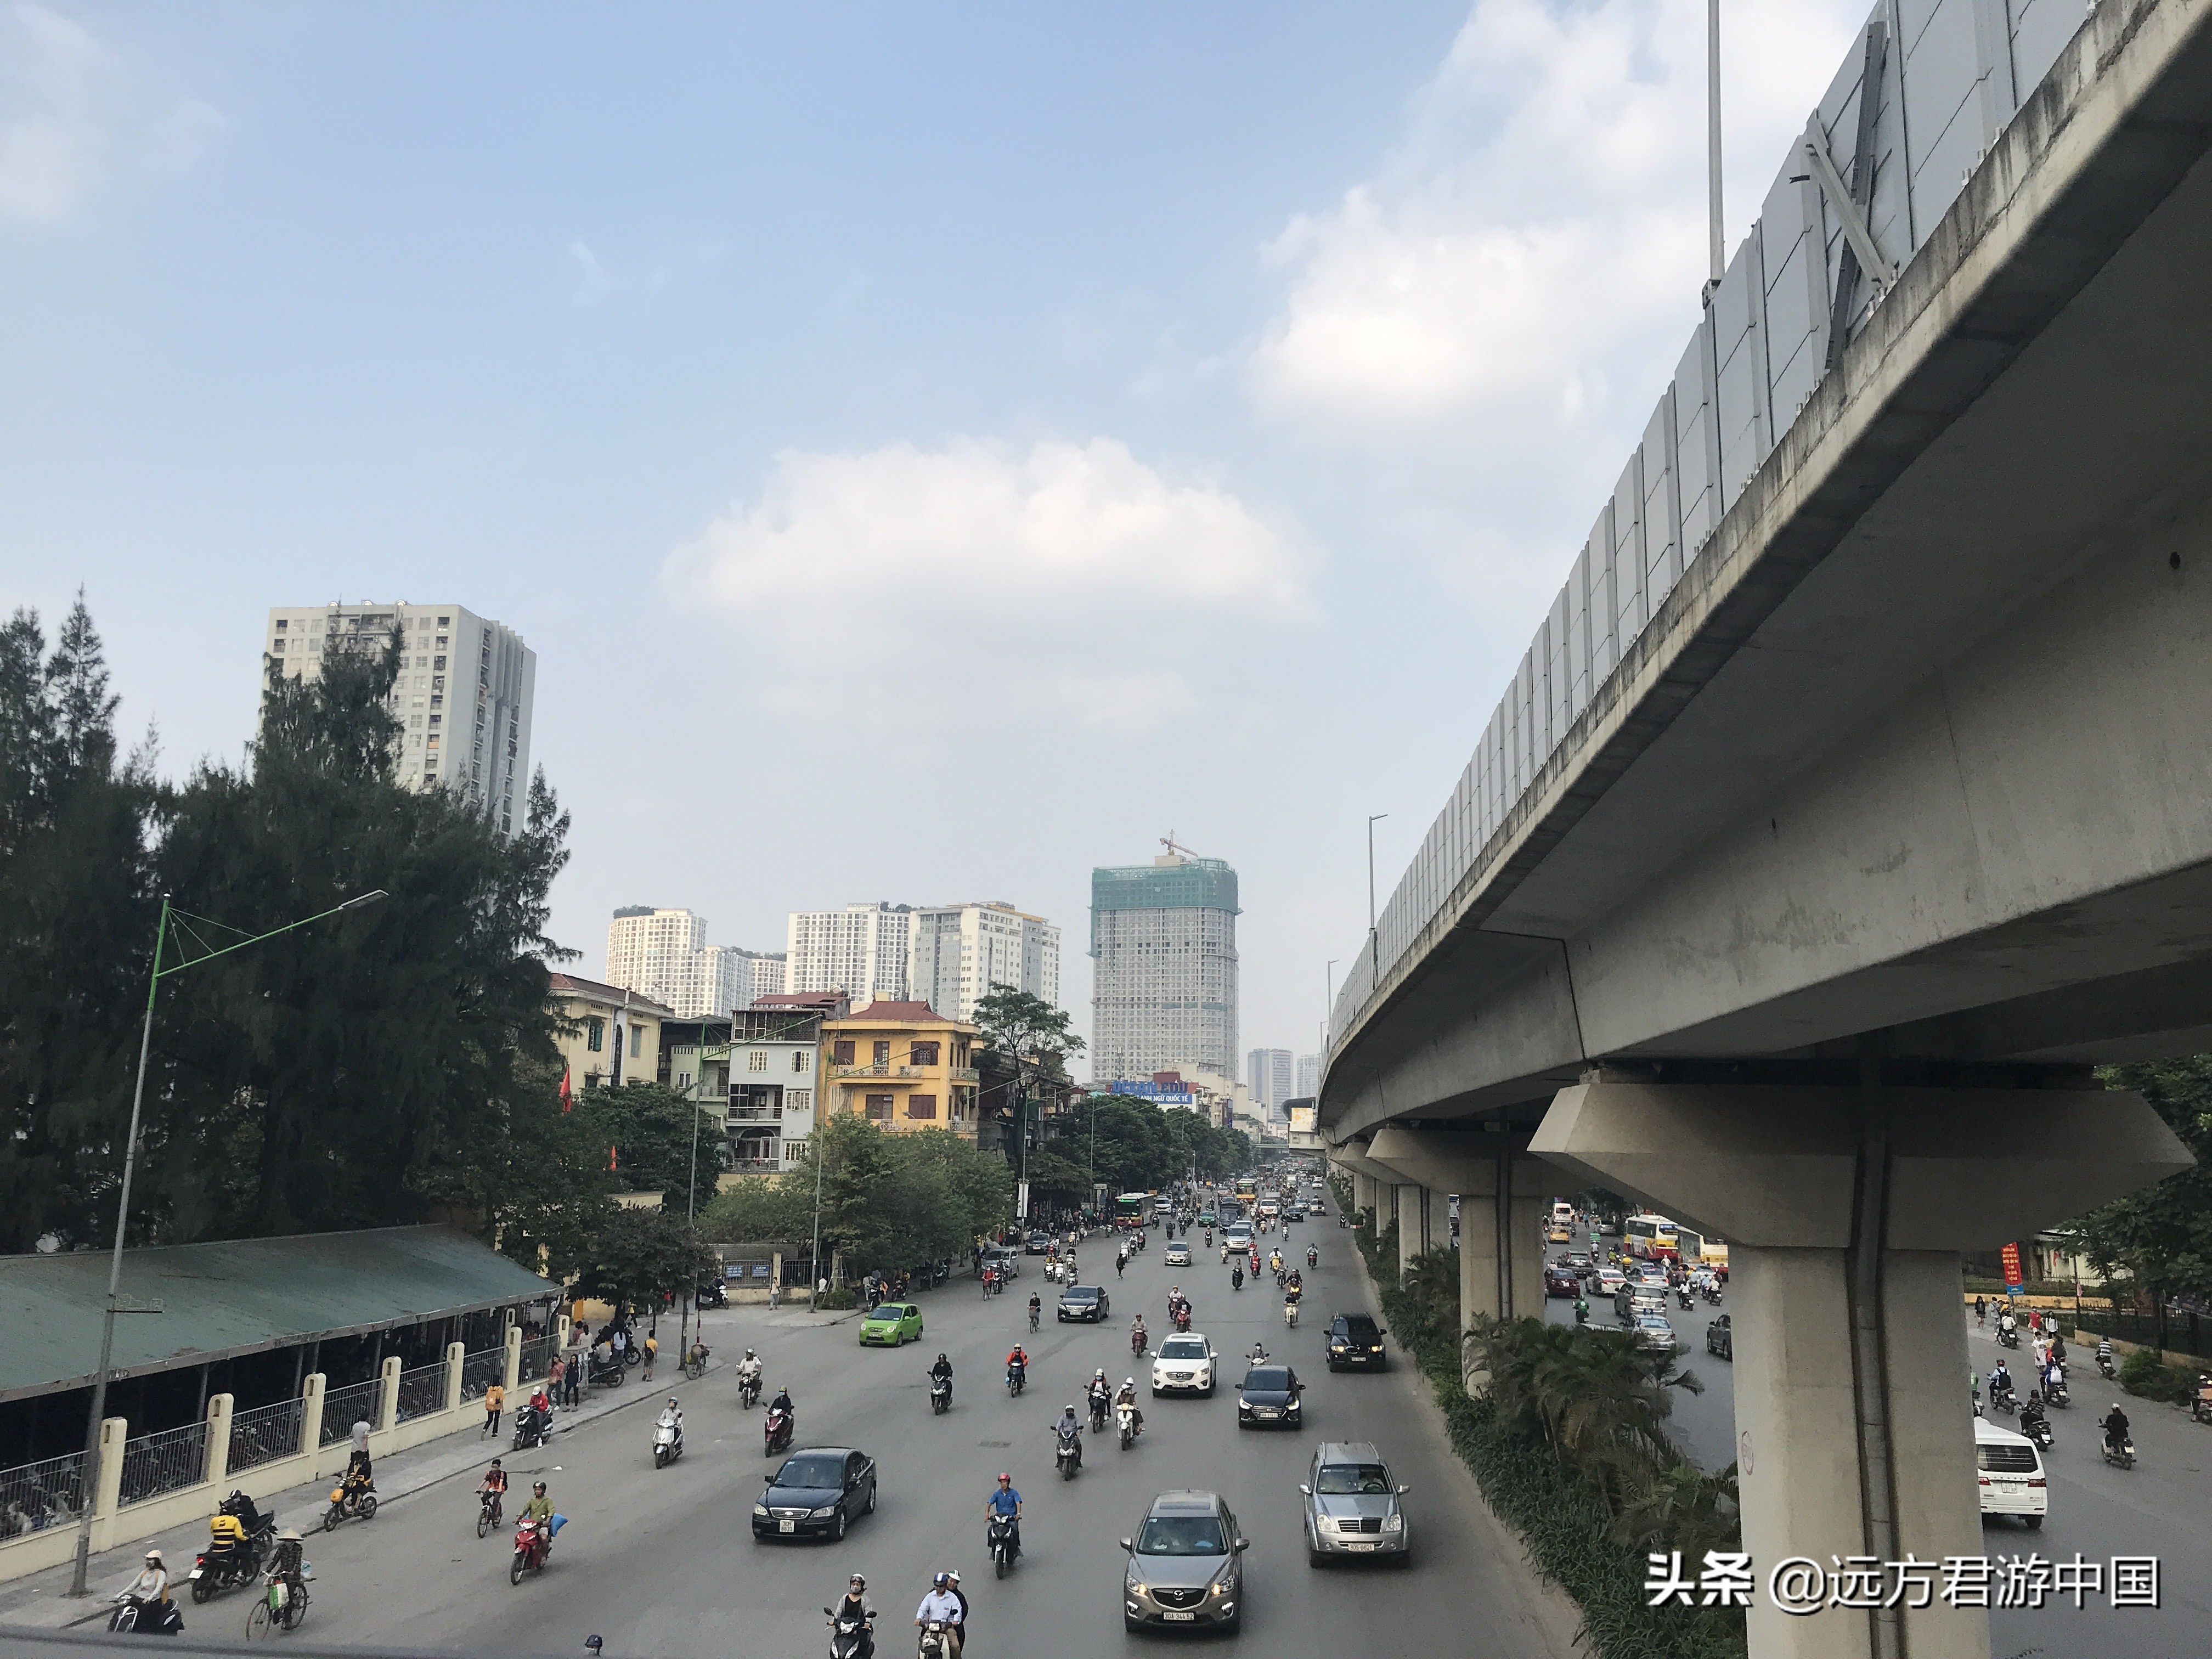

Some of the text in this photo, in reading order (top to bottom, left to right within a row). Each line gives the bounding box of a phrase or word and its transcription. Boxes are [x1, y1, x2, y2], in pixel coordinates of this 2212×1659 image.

[1113, 1080, 1188, 1093] OCEAN EDU
[1166, 1094, 1181, 1102] QUỐC
[1182, 1094, 1188, 1102] TẾ
